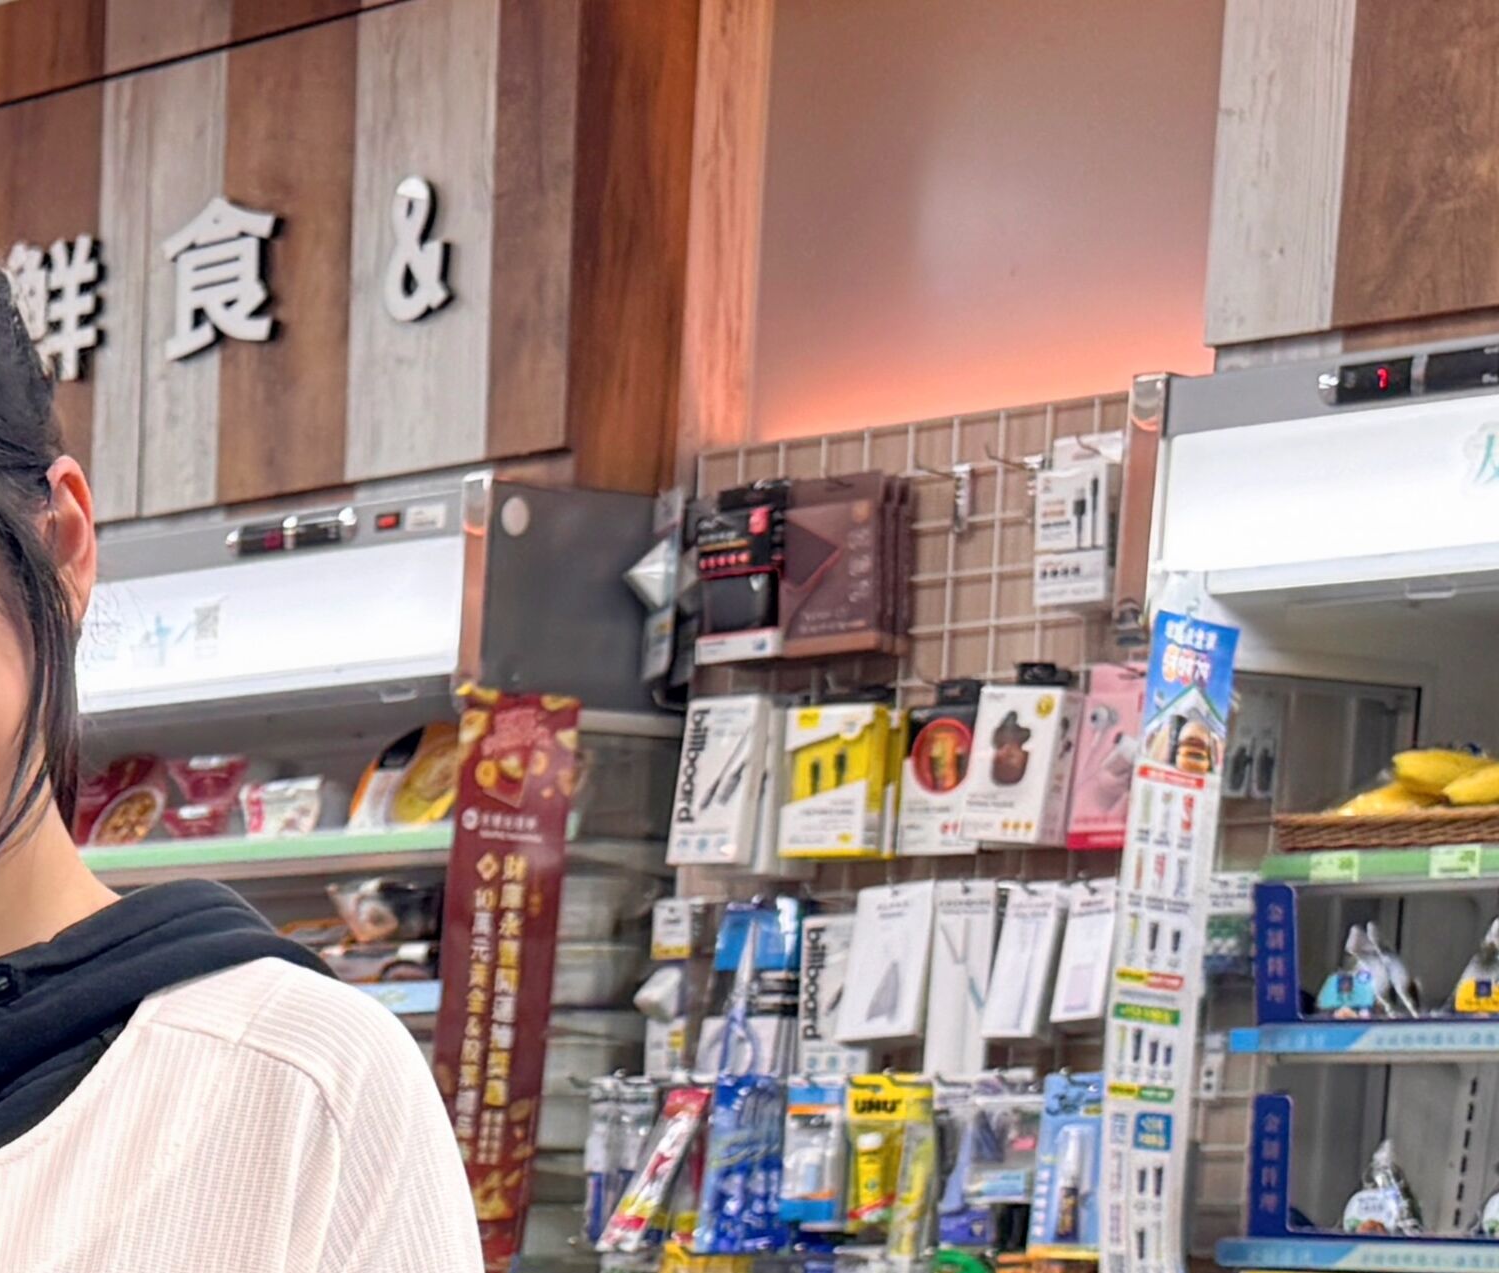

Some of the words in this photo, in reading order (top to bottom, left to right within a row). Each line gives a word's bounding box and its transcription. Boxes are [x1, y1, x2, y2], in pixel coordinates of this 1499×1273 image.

[384, 175, 453, 323] &
[677, 708, 711, 824] billboard
[803, 926, 826, 1041] billboard
